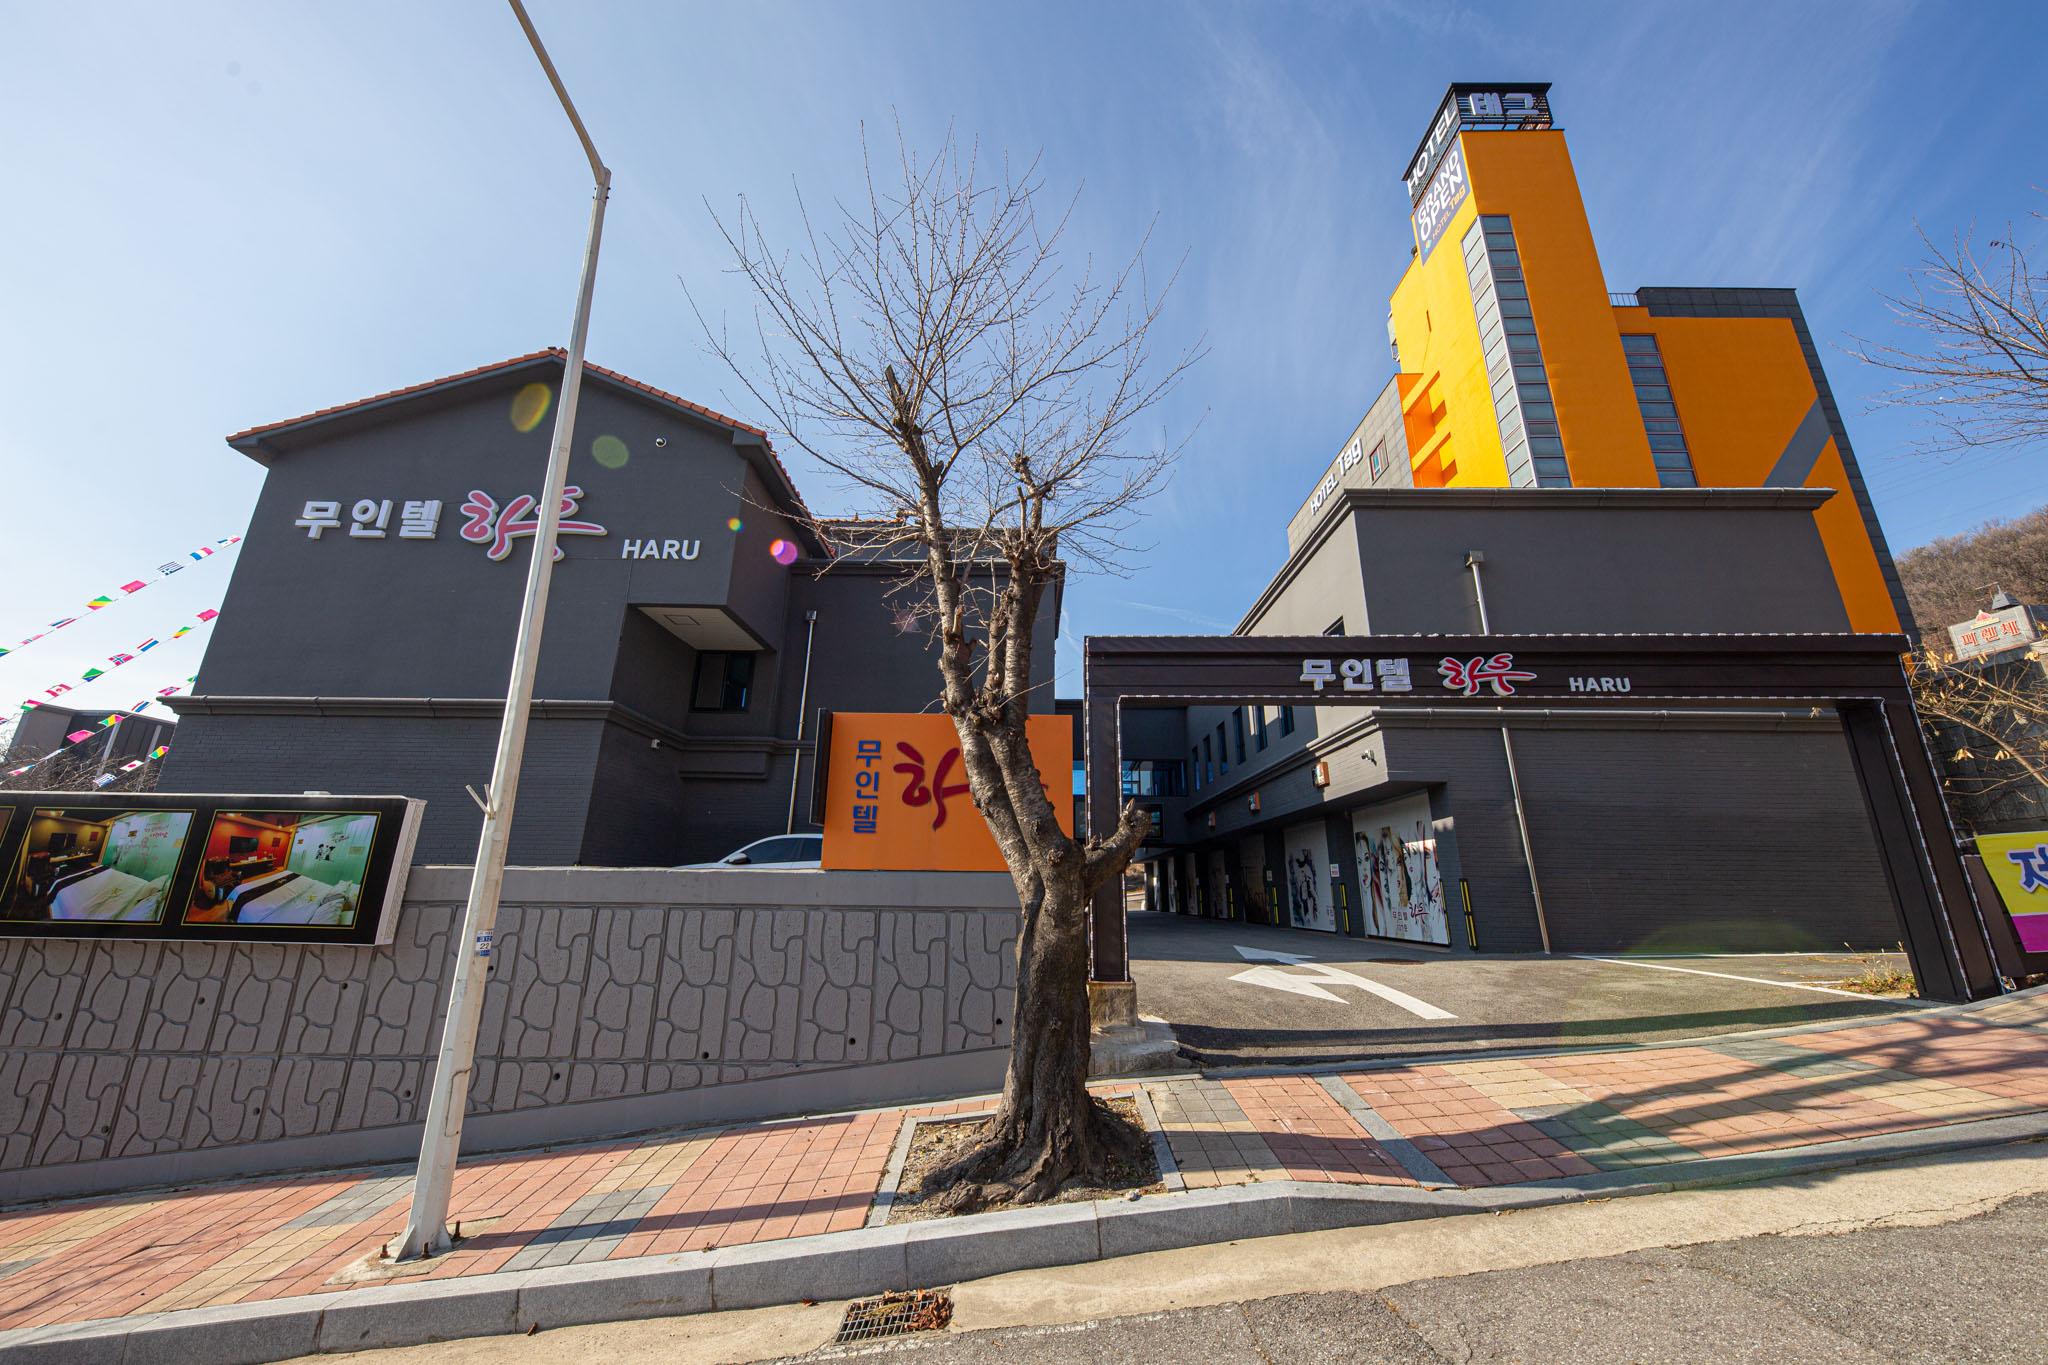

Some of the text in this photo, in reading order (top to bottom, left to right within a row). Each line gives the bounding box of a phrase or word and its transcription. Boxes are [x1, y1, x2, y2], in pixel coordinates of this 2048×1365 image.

[1469, 92, 1539, 116] 태그
[1407, 107, 1457, 197] HOTEL
[1418, 150, 1459, 225] GRAND
[1421, 163, 1463, 241] OPEN
[1432, 211, 1451, 239] HOTEL
[1310, 437, 1364, 516] HOTEL Tag
[294, 498, 442, 539] 무인텔
[621, 539, 701, 560] HARU
[1300, 652, 1631, 696] 무인텔 하루 HARU
[852, 740, 882, 834] 무인텔
